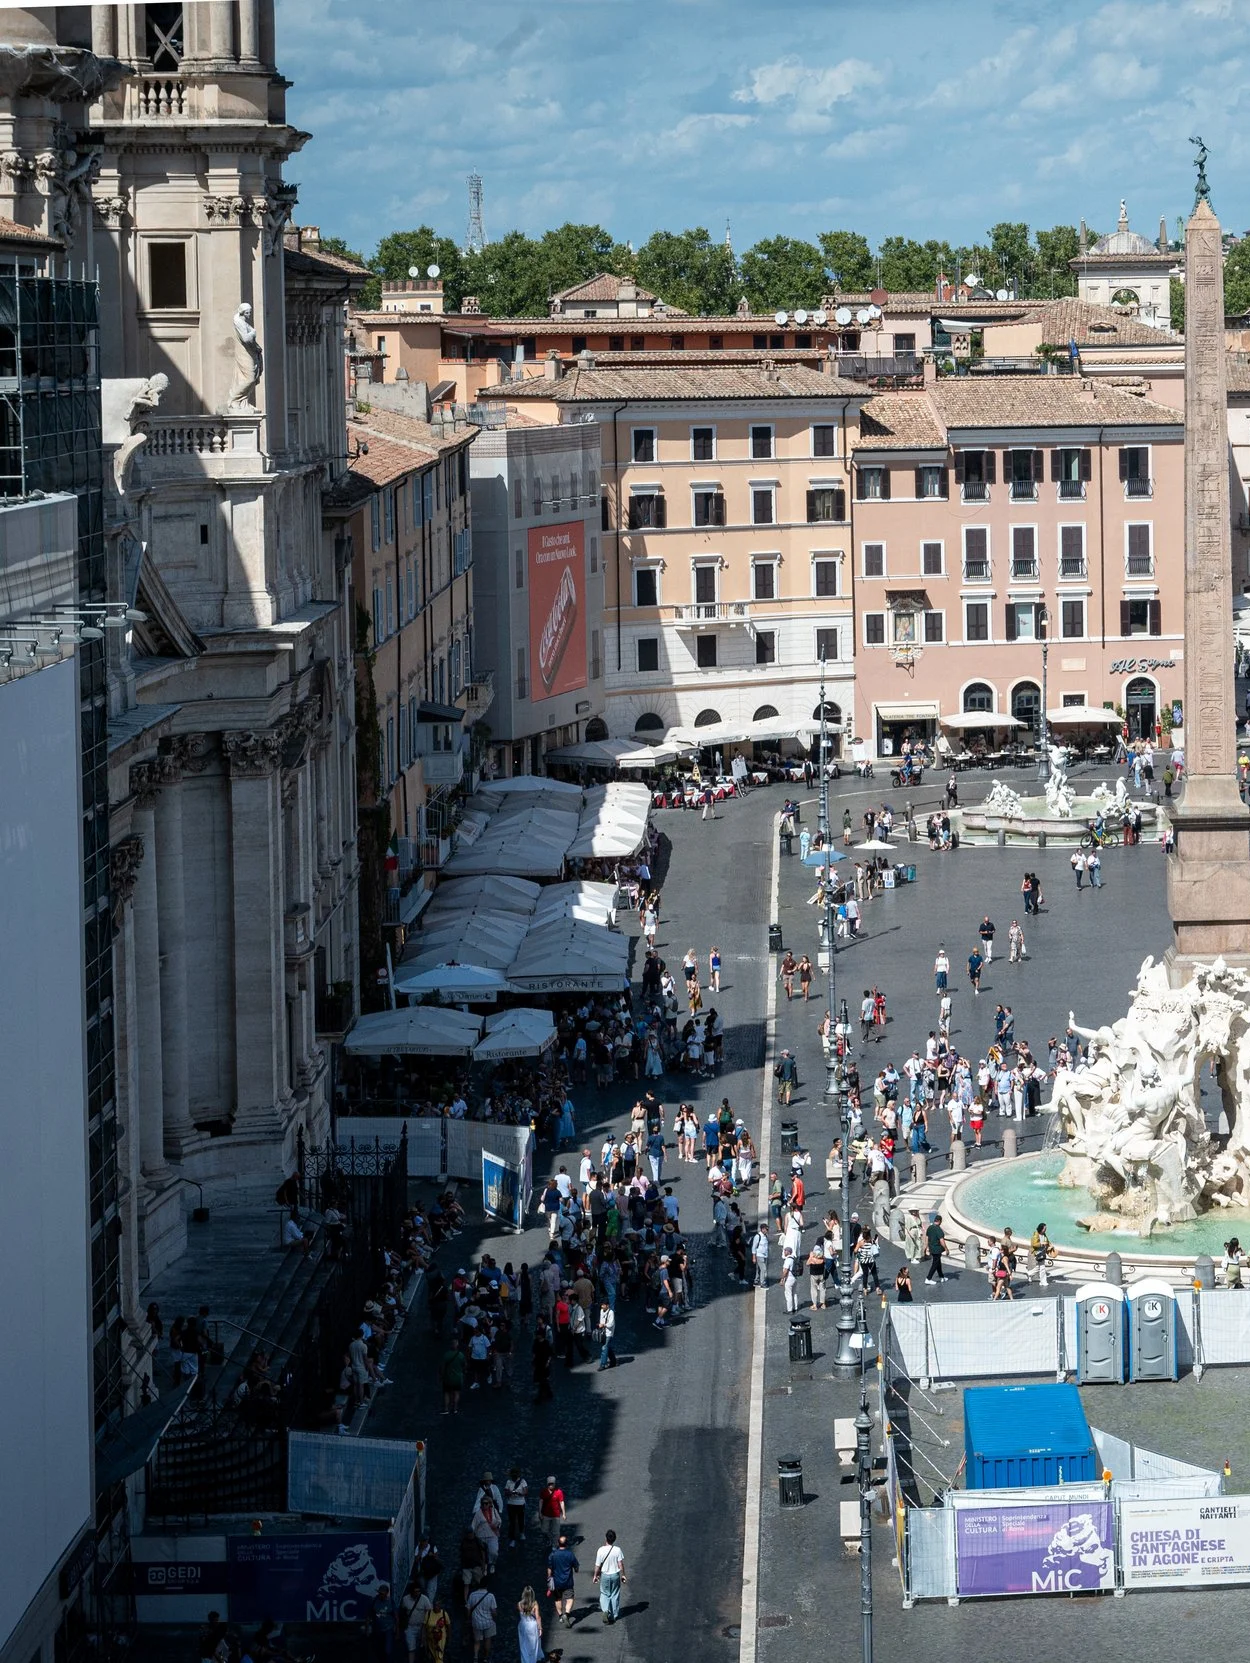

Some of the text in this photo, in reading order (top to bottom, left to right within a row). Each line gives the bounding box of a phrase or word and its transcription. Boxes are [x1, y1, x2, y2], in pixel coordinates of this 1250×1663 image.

[1110, 658, 1176, 674] Al Sogno
[528, 980, 604, 990] RISTORANTE
[486, 1050, 528, 1058] Ristorante
[1002, 1514, 1047, 1522] Soprintendenza
[964, 1526, 998, 1534] CULTURA
[1130, 1528, 1200, 1543] CHIESA DI
[1130, 1539, 1226, 1555] SANT'AGNESE
[1132, 1552, 1234, 1567] IN AGONE E CRIPTA
[168, 1566, 202, 1578] GEDI
[1032, 1568, 1082, 1593] MiC
[306, 1600, 358, 1622] MiC
